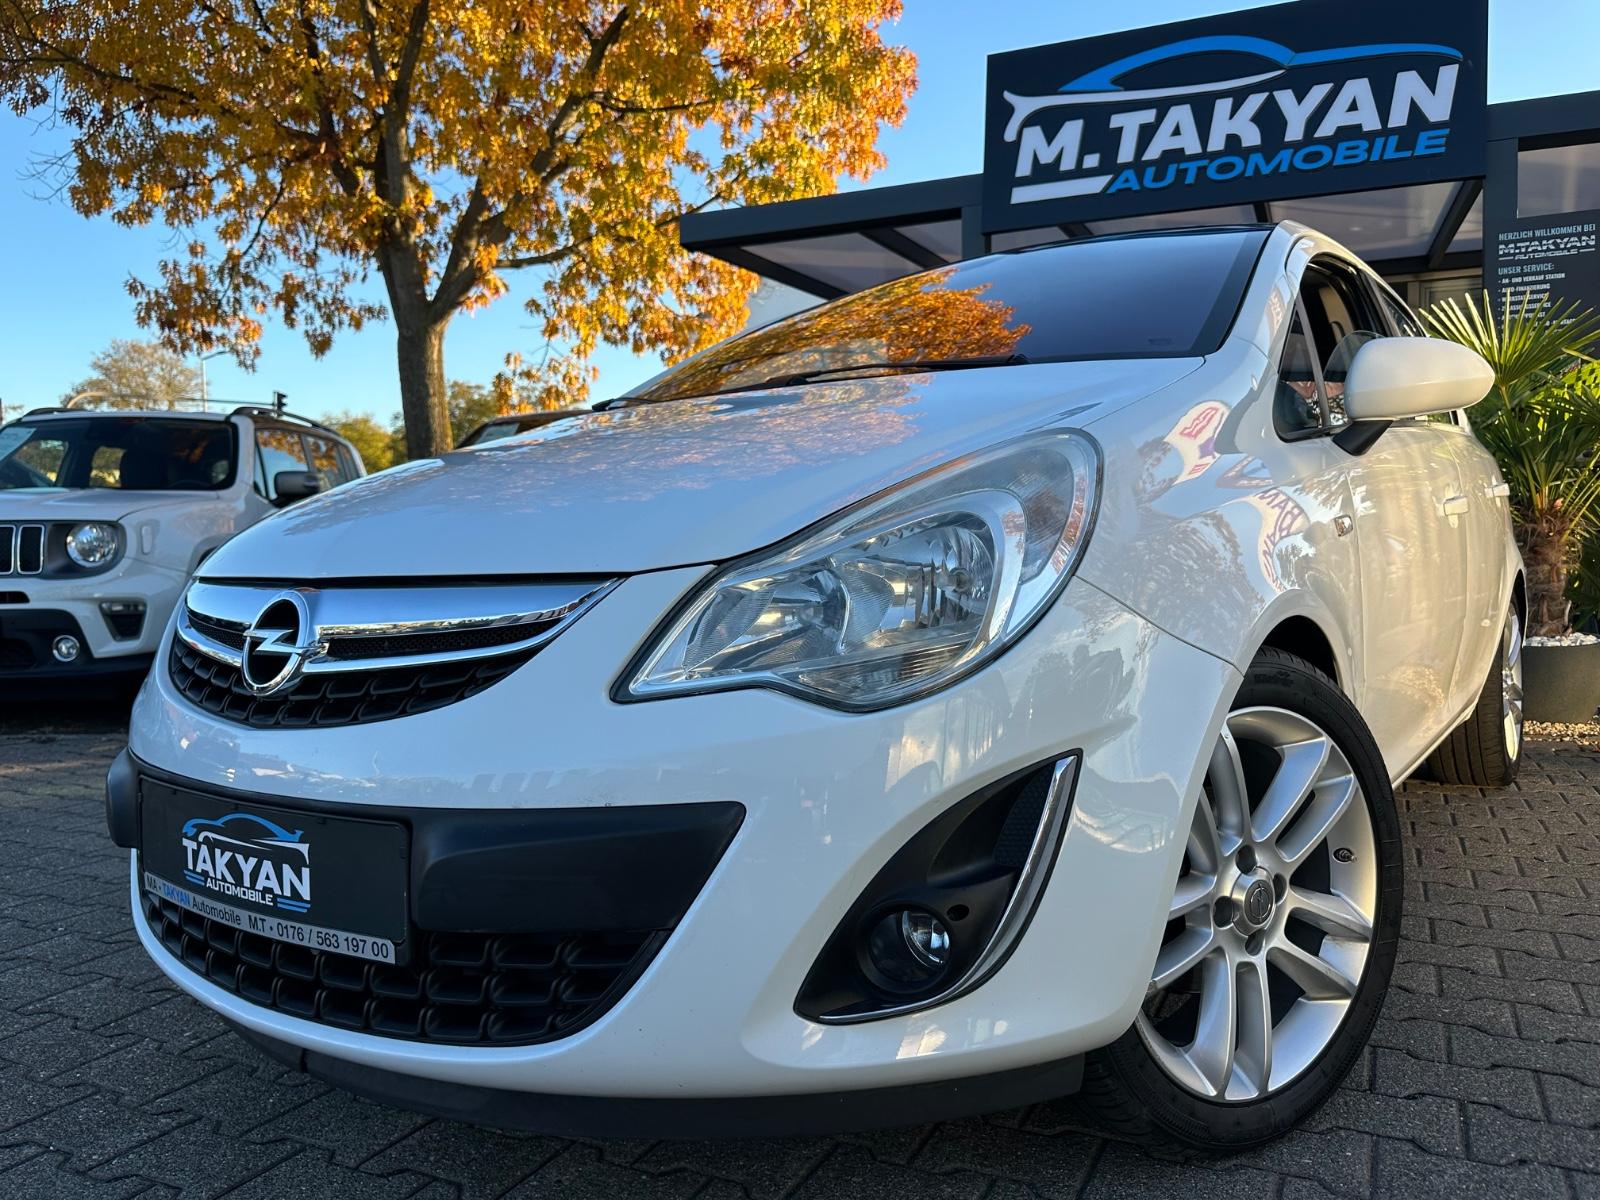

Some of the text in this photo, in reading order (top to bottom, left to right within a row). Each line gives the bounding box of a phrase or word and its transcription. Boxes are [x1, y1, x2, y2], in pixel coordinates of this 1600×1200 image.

[1106, 128, 1450, 194] AUTOMOBILE
[1498, 223, 1596, 241] HERZLICH WILLKOMMEN BEI
[1498, 262, 1555, 275] UNSER SERVICE:
[182, 838, 311, 901] TAKYAN
[206, 878, 274, 906] AUTOMOBILE
[162, 883, 191, 906] TAKYAN
[192, 895, 241, 925] Automobile
[248, 915, 266, 933] M.T
[277, 922, 305, 942] 0176
[317, 931, 340, 949] 563
[344, 936, 367, 954] 197
[371, 941, 389, 959] 00
